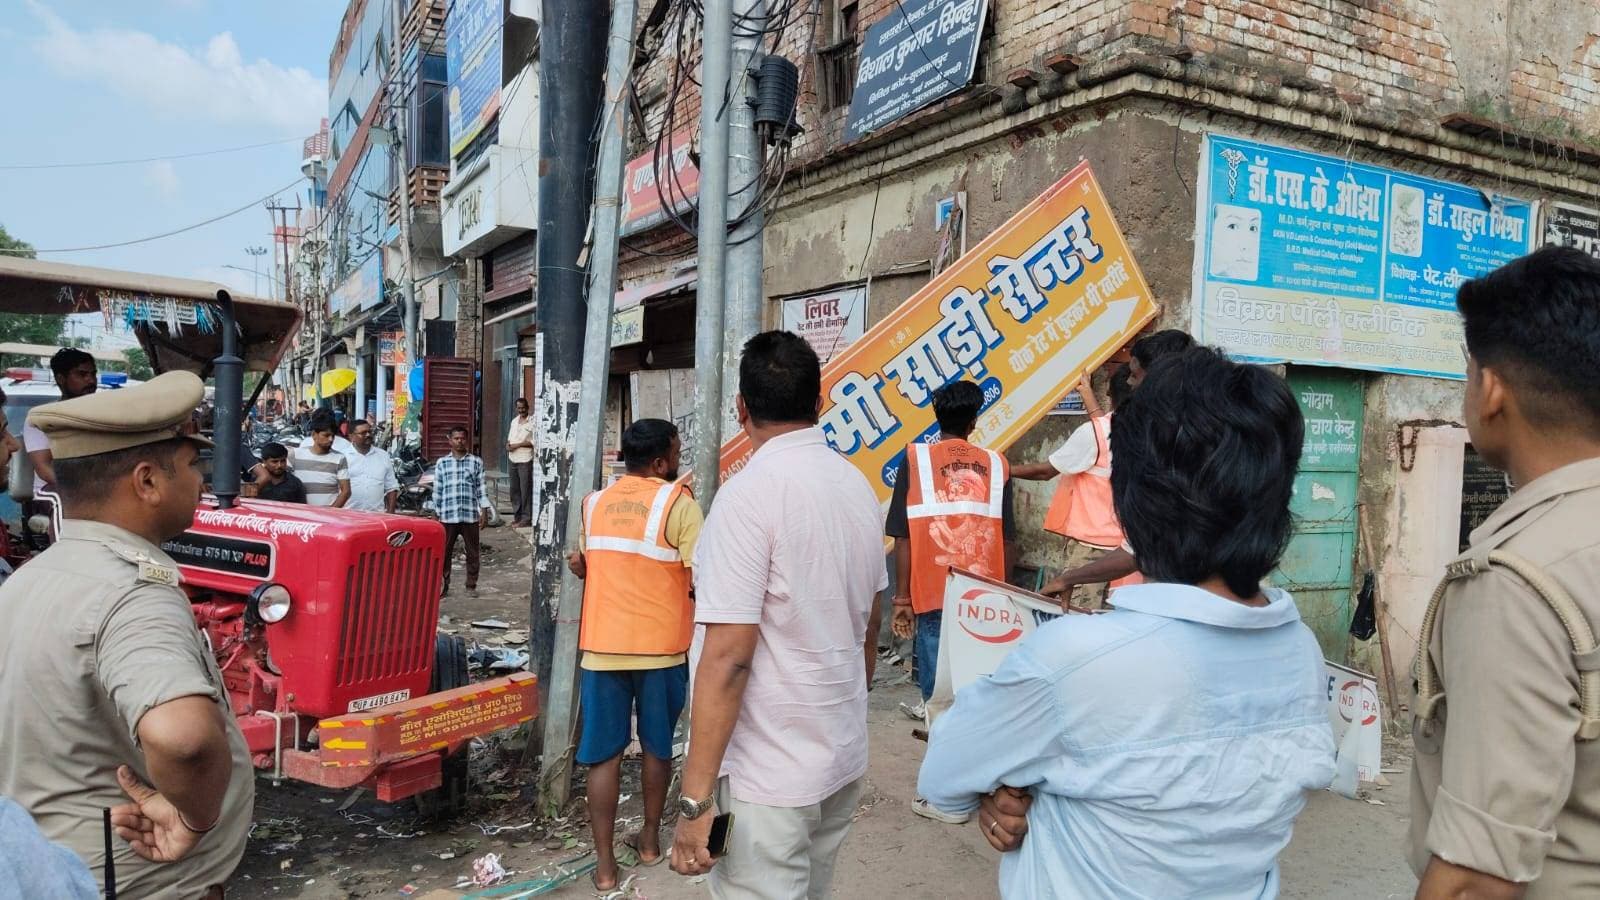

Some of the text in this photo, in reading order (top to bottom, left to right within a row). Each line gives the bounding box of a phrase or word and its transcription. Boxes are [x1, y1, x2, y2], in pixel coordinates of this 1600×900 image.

[856, 46, 897, 88] विशाल
[895, 20, 938, 71] कुमार
[1489, 202, 1525, 243] मिश्रा
[805, 298, 840, 320] लिवर
[1216, 287, 1288, 325] विक्रम
[819, 205, 1105, 456] मी साड़ी सेन्टर
[1301, 385, 1334, 410] गोदाम
[1311, 419, 1333, 435] चाय
[244, 553, 269, 567] PLUS
[958, 603, 1024, 627] INDRA
